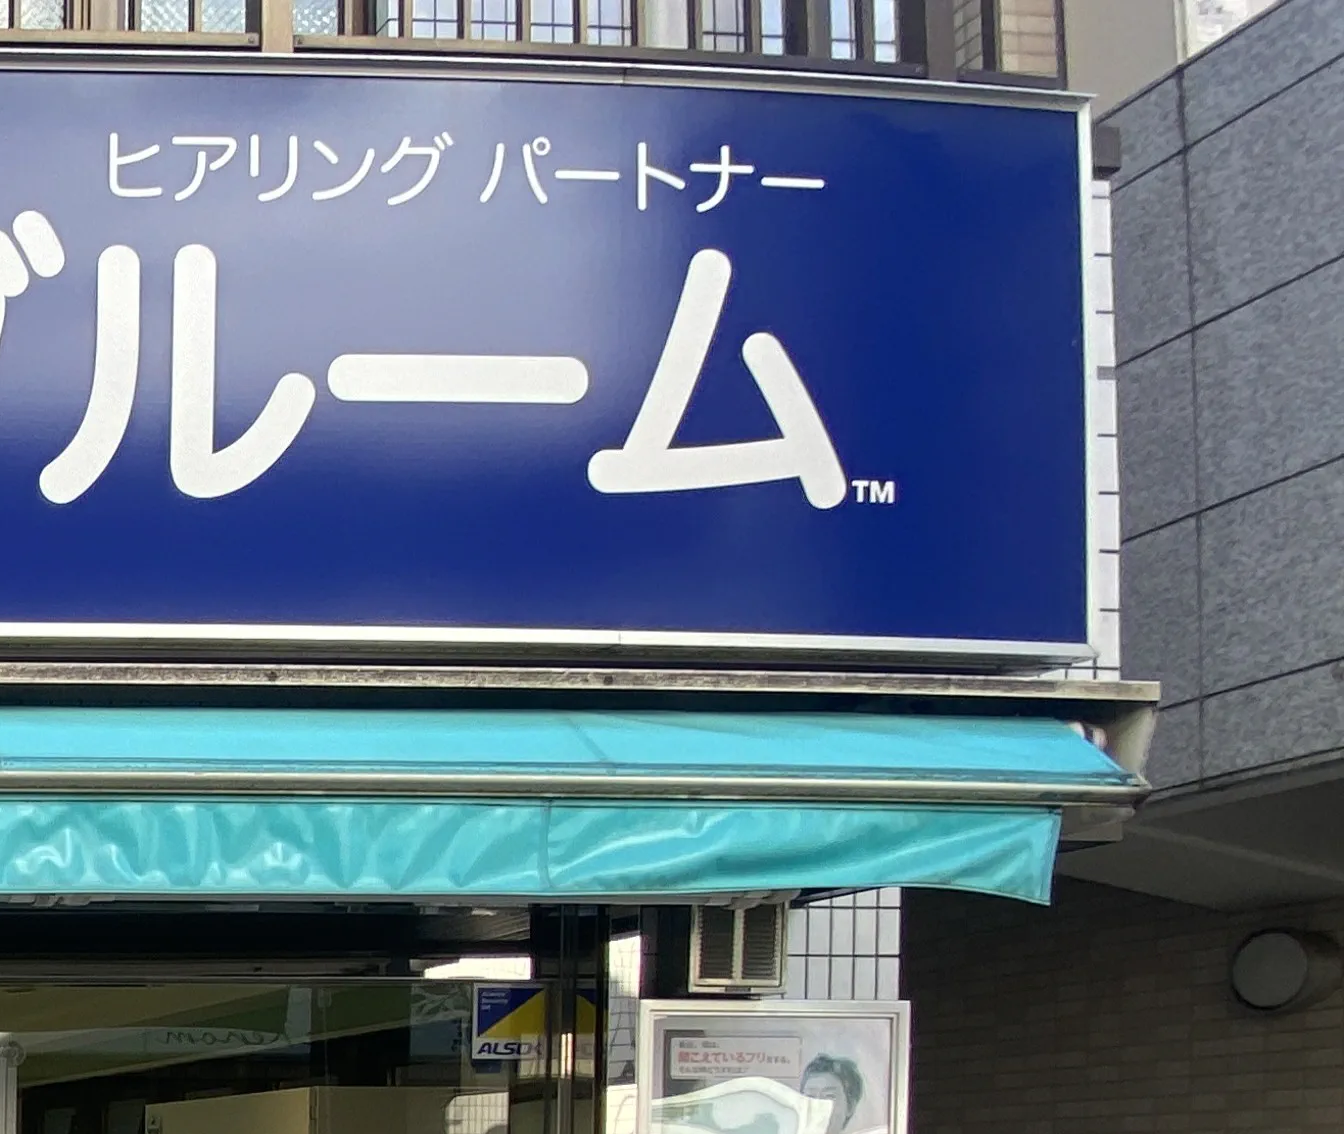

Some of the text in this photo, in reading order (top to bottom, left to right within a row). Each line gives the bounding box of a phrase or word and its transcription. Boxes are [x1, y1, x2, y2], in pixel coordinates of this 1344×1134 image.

[108, 132, 826, 214] ヒアリング パートナー
[852, 480, 895, 504] TM
